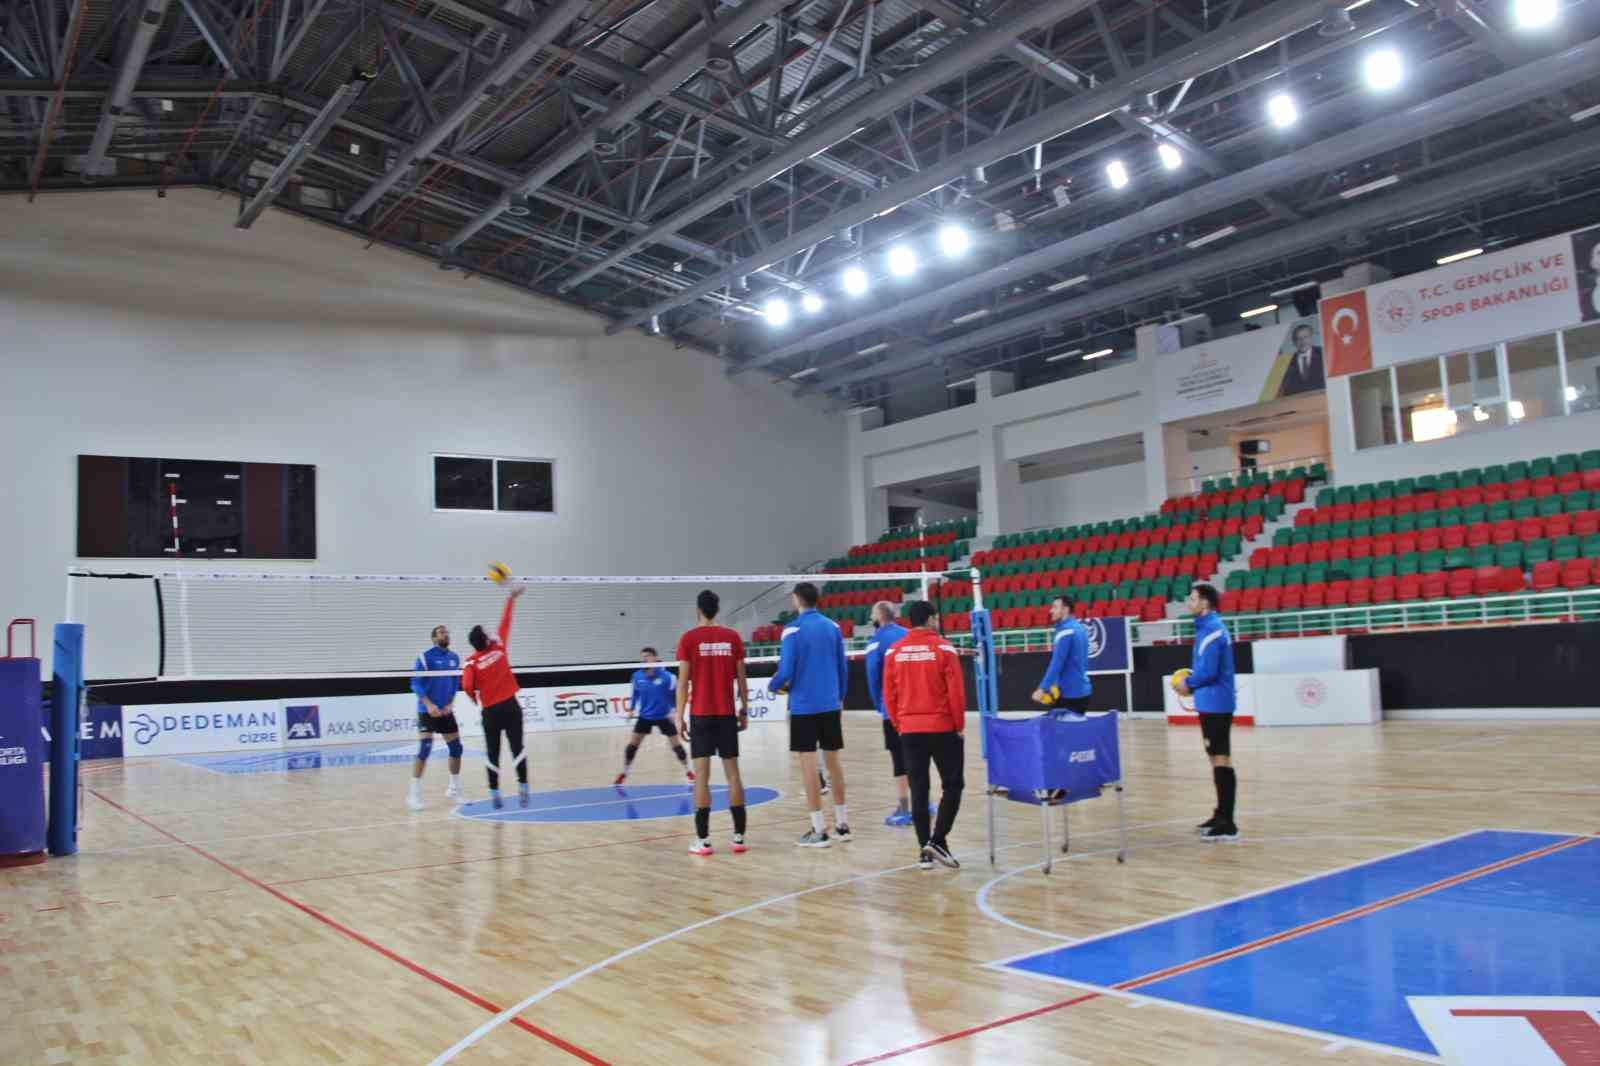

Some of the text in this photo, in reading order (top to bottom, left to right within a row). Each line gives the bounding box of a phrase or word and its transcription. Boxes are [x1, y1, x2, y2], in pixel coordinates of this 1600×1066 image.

[1418, 253, 1565, 299] T.C. GENÇLİK VE
[1422, 276, 1569, 322] SPOR BAKANLIĞI
[162, 712, 276, 731] DEDEMAN
[288, 722, 316, 737] AXA
[327, 720, 355, 735] AXA
